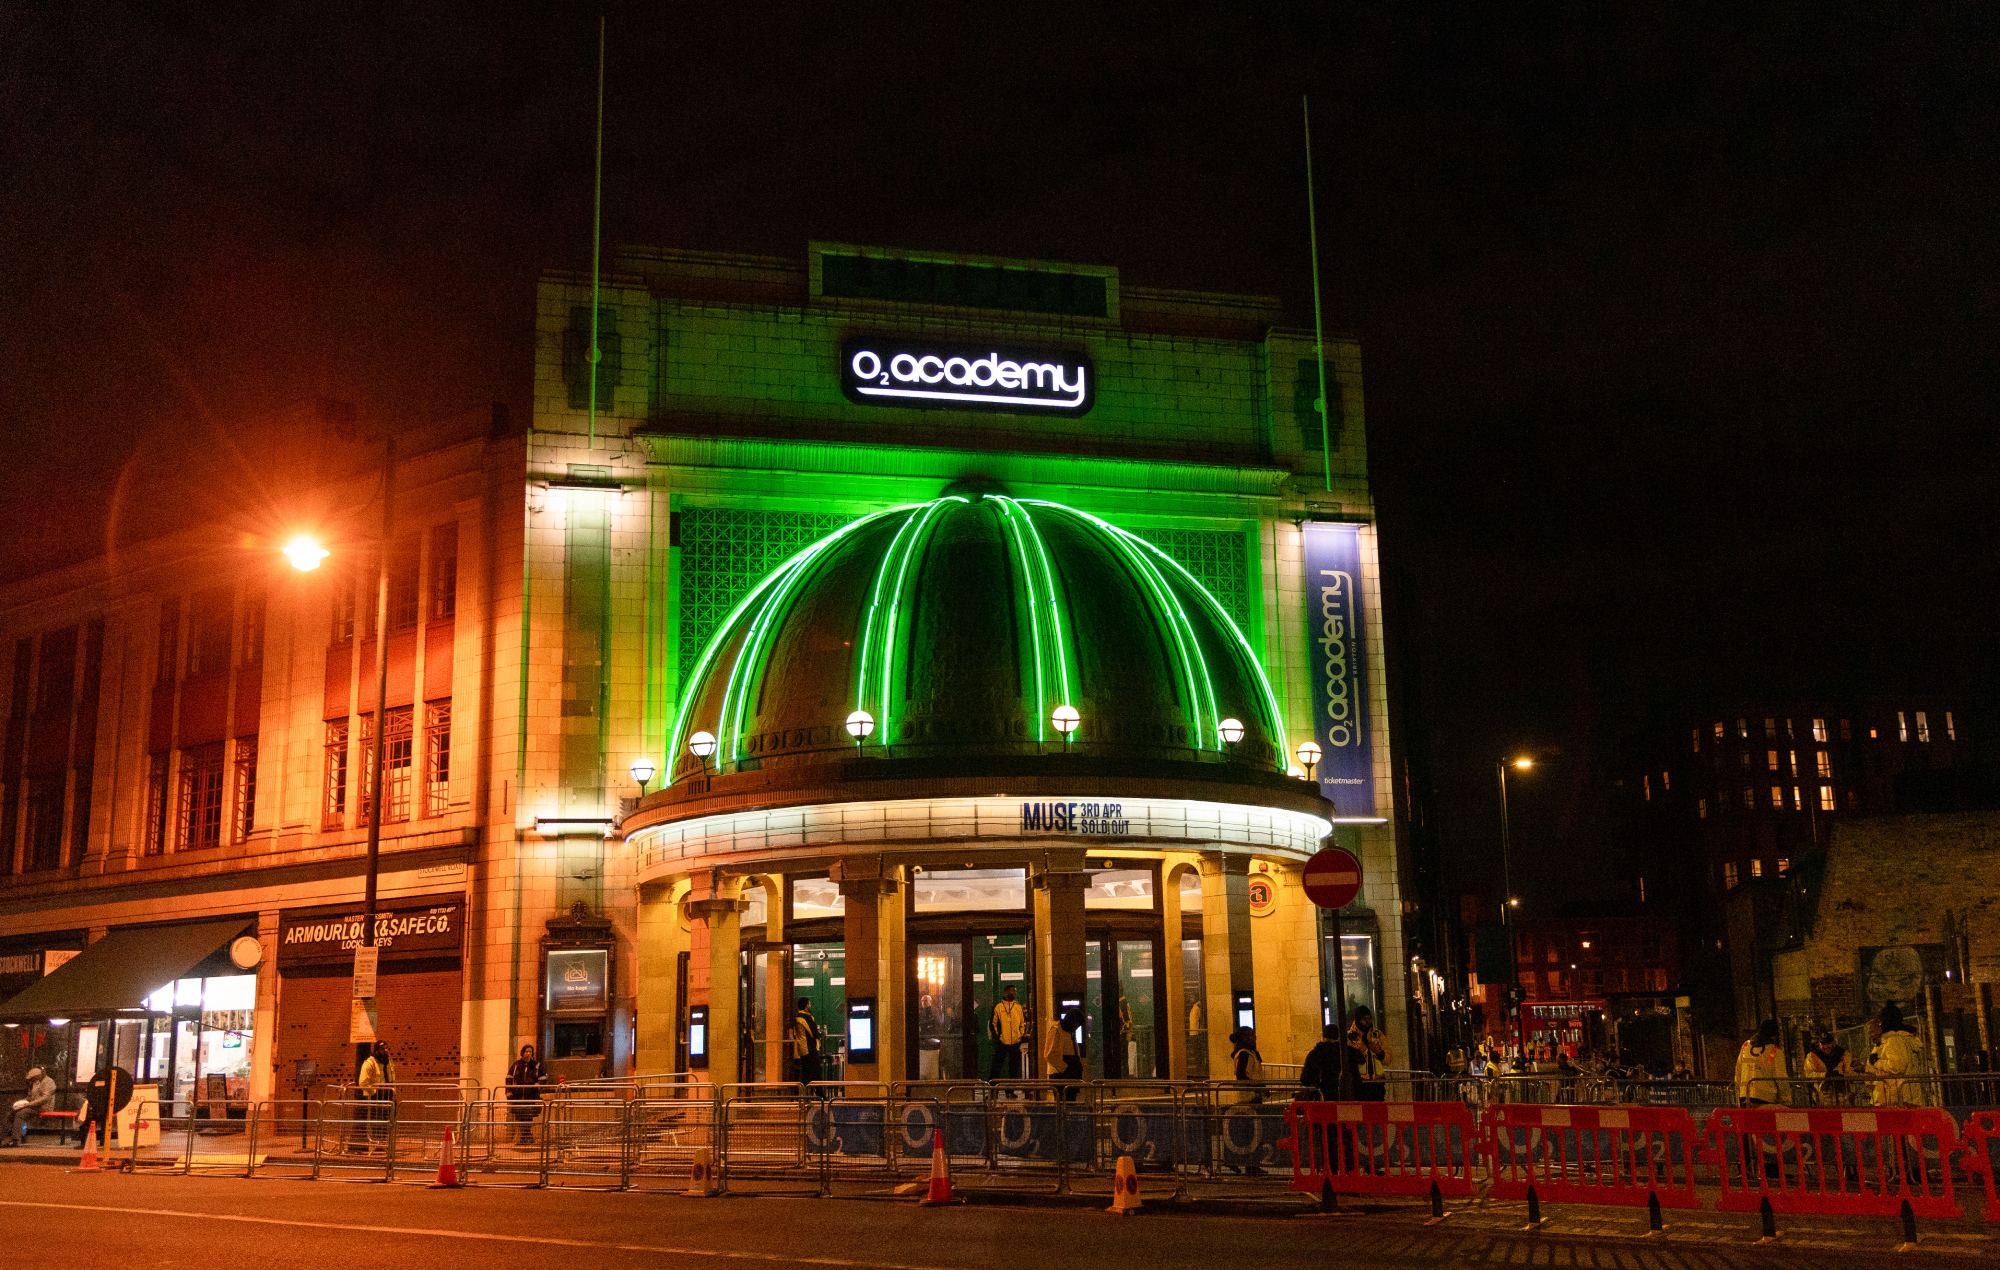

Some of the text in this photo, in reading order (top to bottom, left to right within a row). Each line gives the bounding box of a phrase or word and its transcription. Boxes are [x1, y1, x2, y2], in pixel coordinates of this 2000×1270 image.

[890, 352, 1085, 408] academy
[1318, 569, 1353, 720] academy
[1324, 776, 1363, 785] ticketmaster
[1023, 802, 1122, 832] MUSE 3RD APR
[1081, 819, 1130, 834] SOLD OUT
